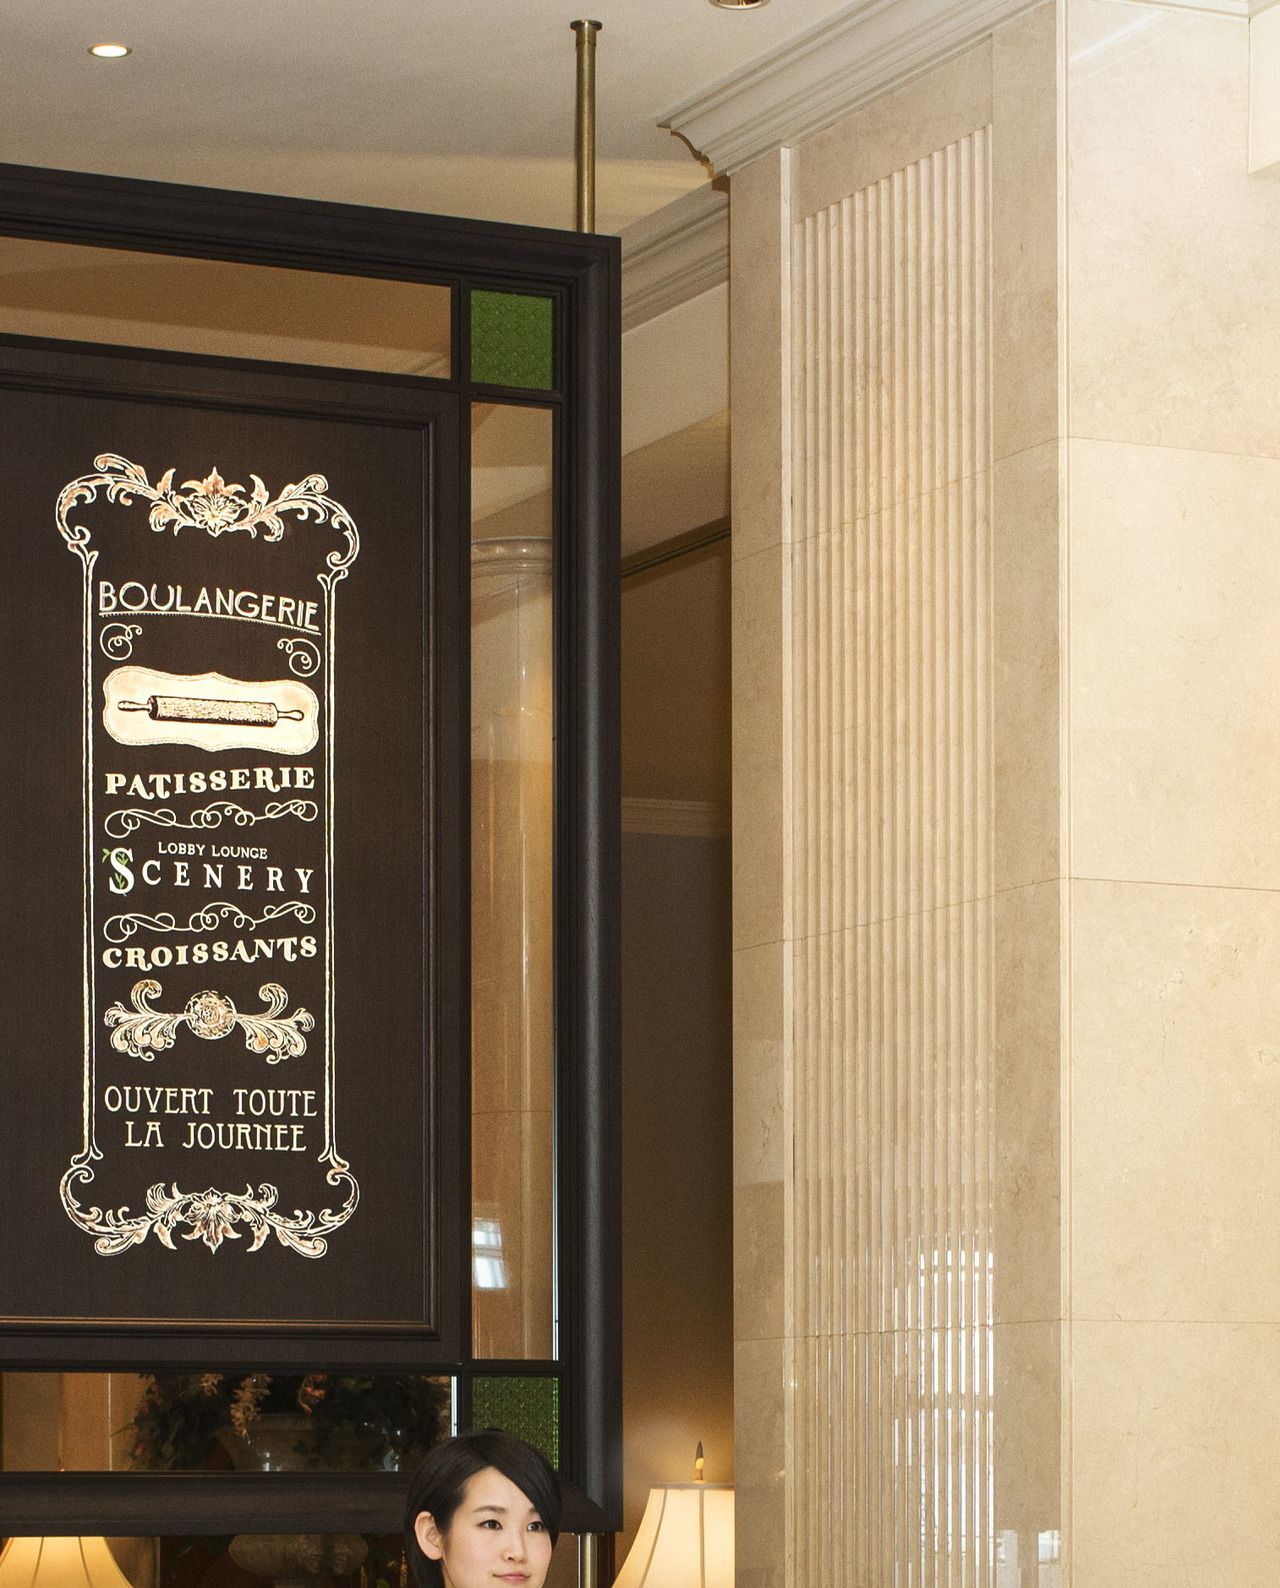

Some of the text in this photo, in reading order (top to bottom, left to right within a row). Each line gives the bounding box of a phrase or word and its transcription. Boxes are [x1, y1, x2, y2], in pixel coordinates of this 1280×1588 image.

[99, 581, 320, 631] BOULANGERIE
[105, 767, 315, 800] PATISSERIE
[158, 842, 268, 860] LOBBY LOUNGE
[109, 848, 314, 895] SCENERY
[102, 936, 317, 971] CROISSANTS
[104, 1085, 318, 1117] OUVERT TOUTE
[124, 1121, 307, 1152] LA JOURNEE
